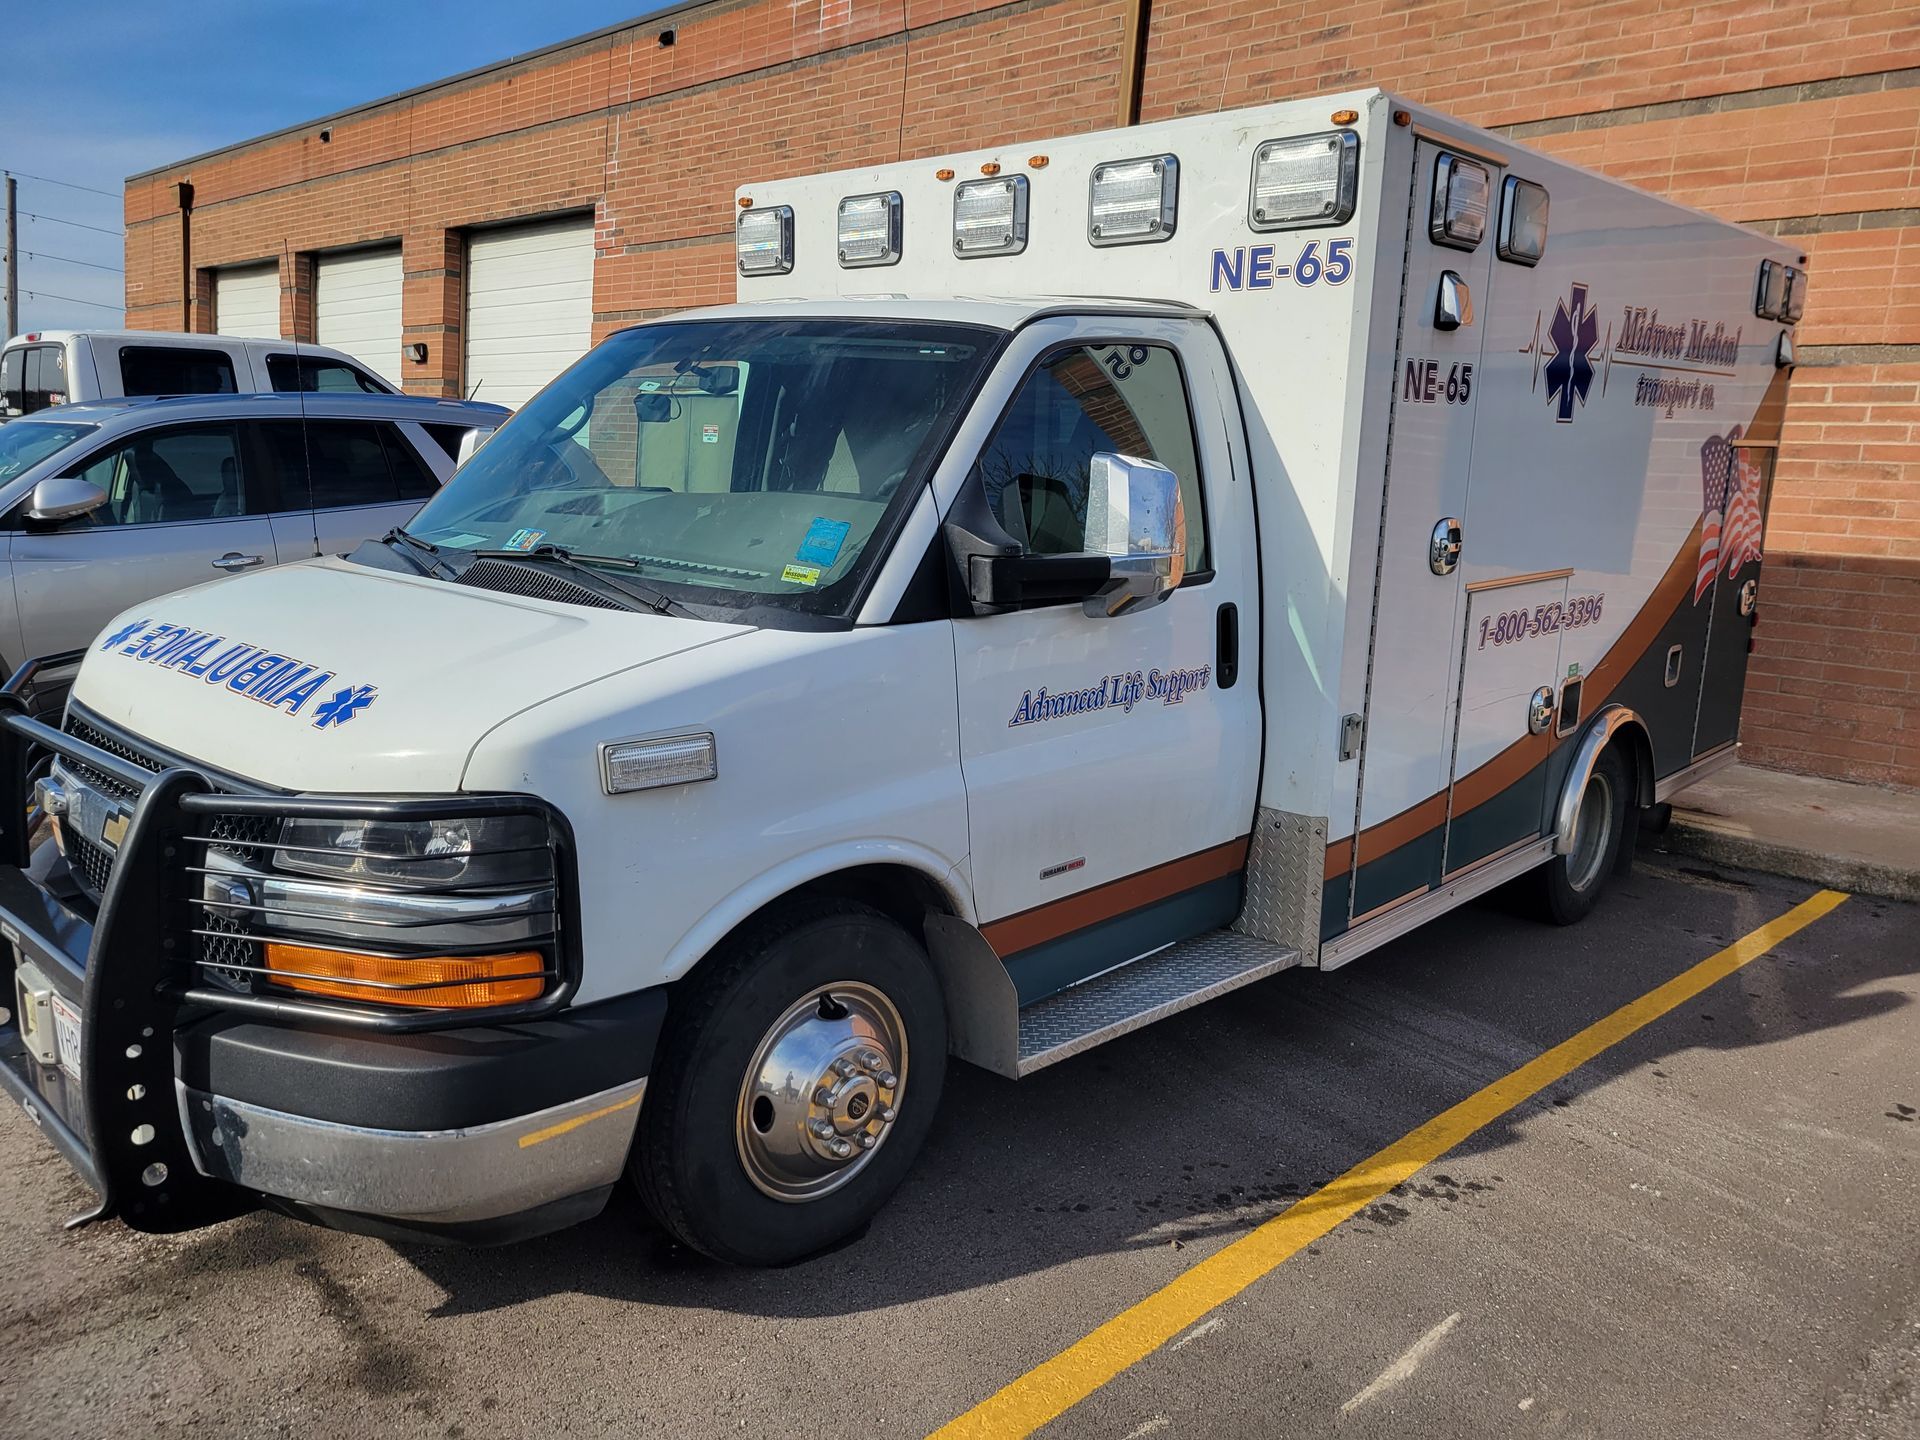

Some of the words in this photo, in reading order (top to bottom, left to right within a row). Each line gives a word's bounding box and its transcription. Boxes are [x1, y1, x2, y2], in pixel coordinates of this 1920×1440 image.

[1210, 237, 1354, 293] NE-65
[1615, 305, 1687, 360] Midwest
[1683, 319, 1742, 367] Medical
[1403, 357, 1473, 405] NE-65
[1635, 372, 1701, 419] transport
[1478, 593, 1605, 650] 1-800-562-3396
[1008, 676, 1109, 727] Advanced
[1107, 671, 1145, 713] Life
[1145, 664, 1211, 706] Support
